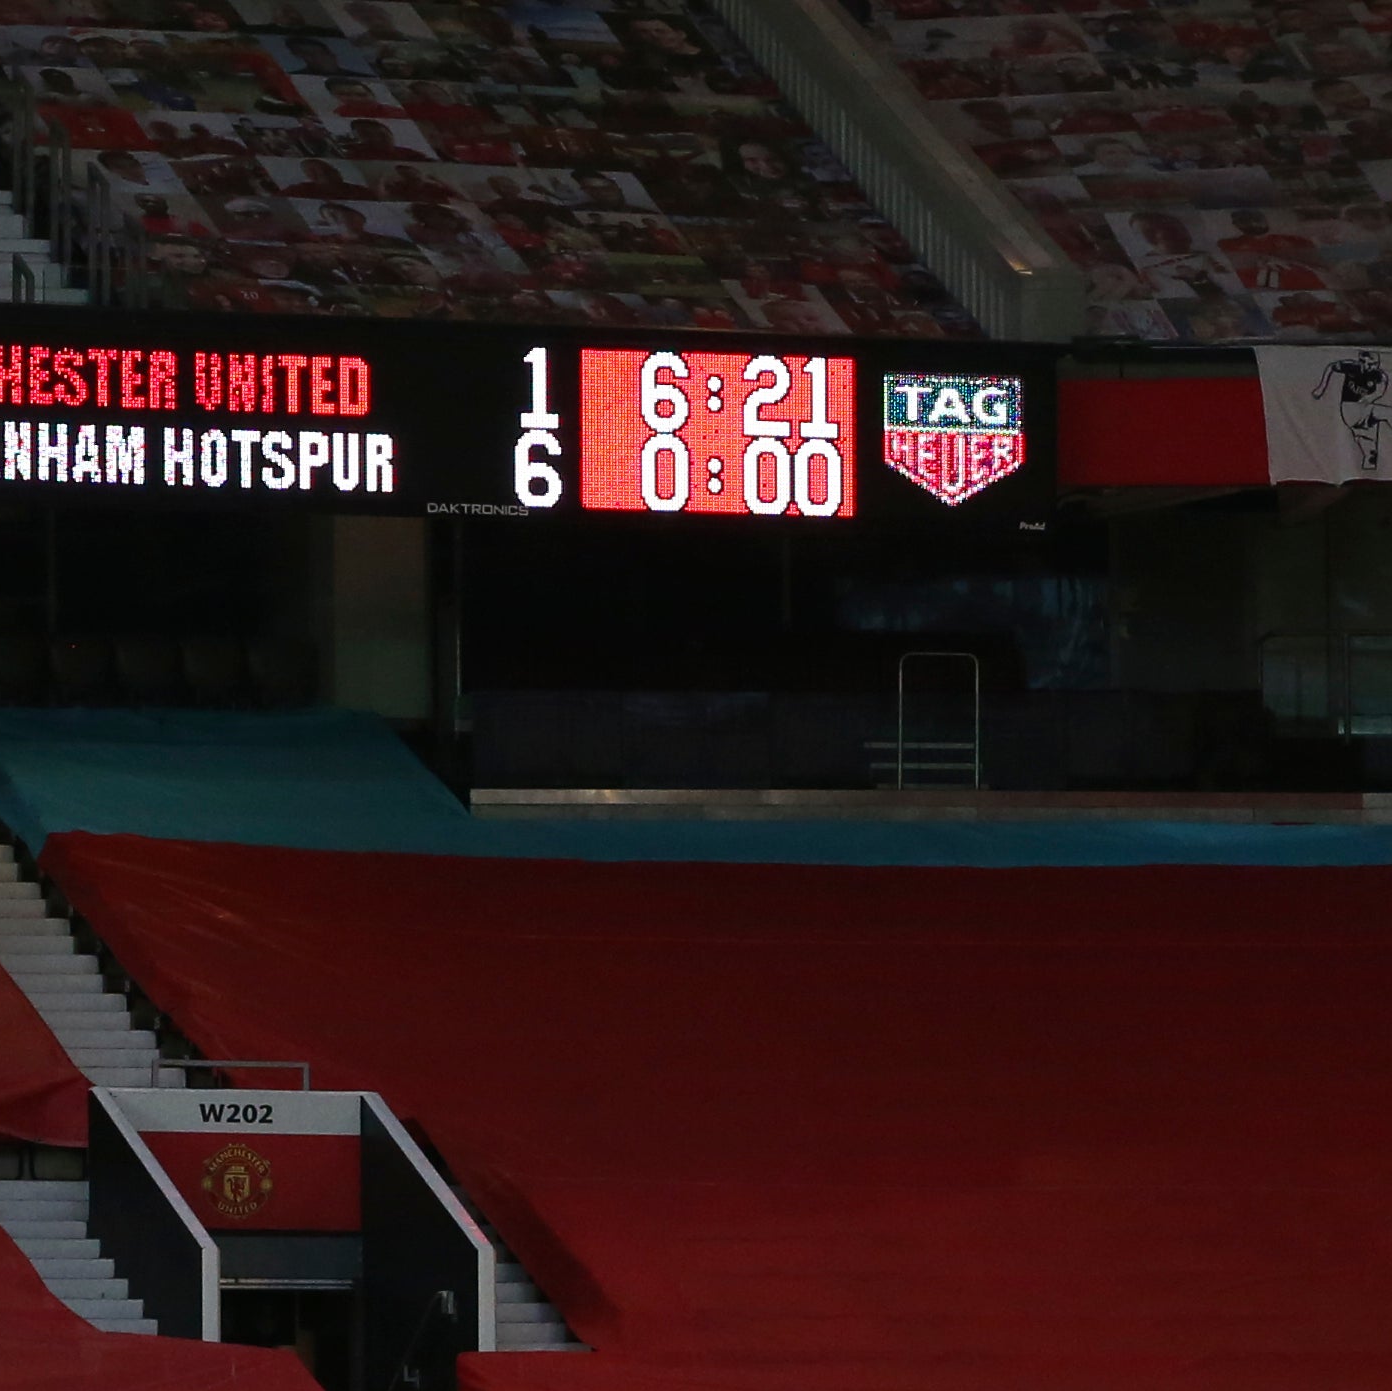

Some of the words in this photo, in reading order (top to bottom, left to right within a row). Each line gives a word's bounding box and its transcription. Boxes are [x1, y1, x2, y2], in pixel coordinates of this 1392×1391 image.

[195, 352, 371, 416] UNITED
[520, 347, 559, 430] 1
[640, 350, 839, 439] 6:21
[894, 386, 1008, 424] TAG
[163, 427, 396, 493] HOTSPUR
[514, 430, 562, 508] 6
[640, 432, 844, 517] 0:00
[890, 433, 1015, 492] HEUER
[427, 502, 529, 517] DAKTRONICS
[199, 1103, 273, 1124] W202
